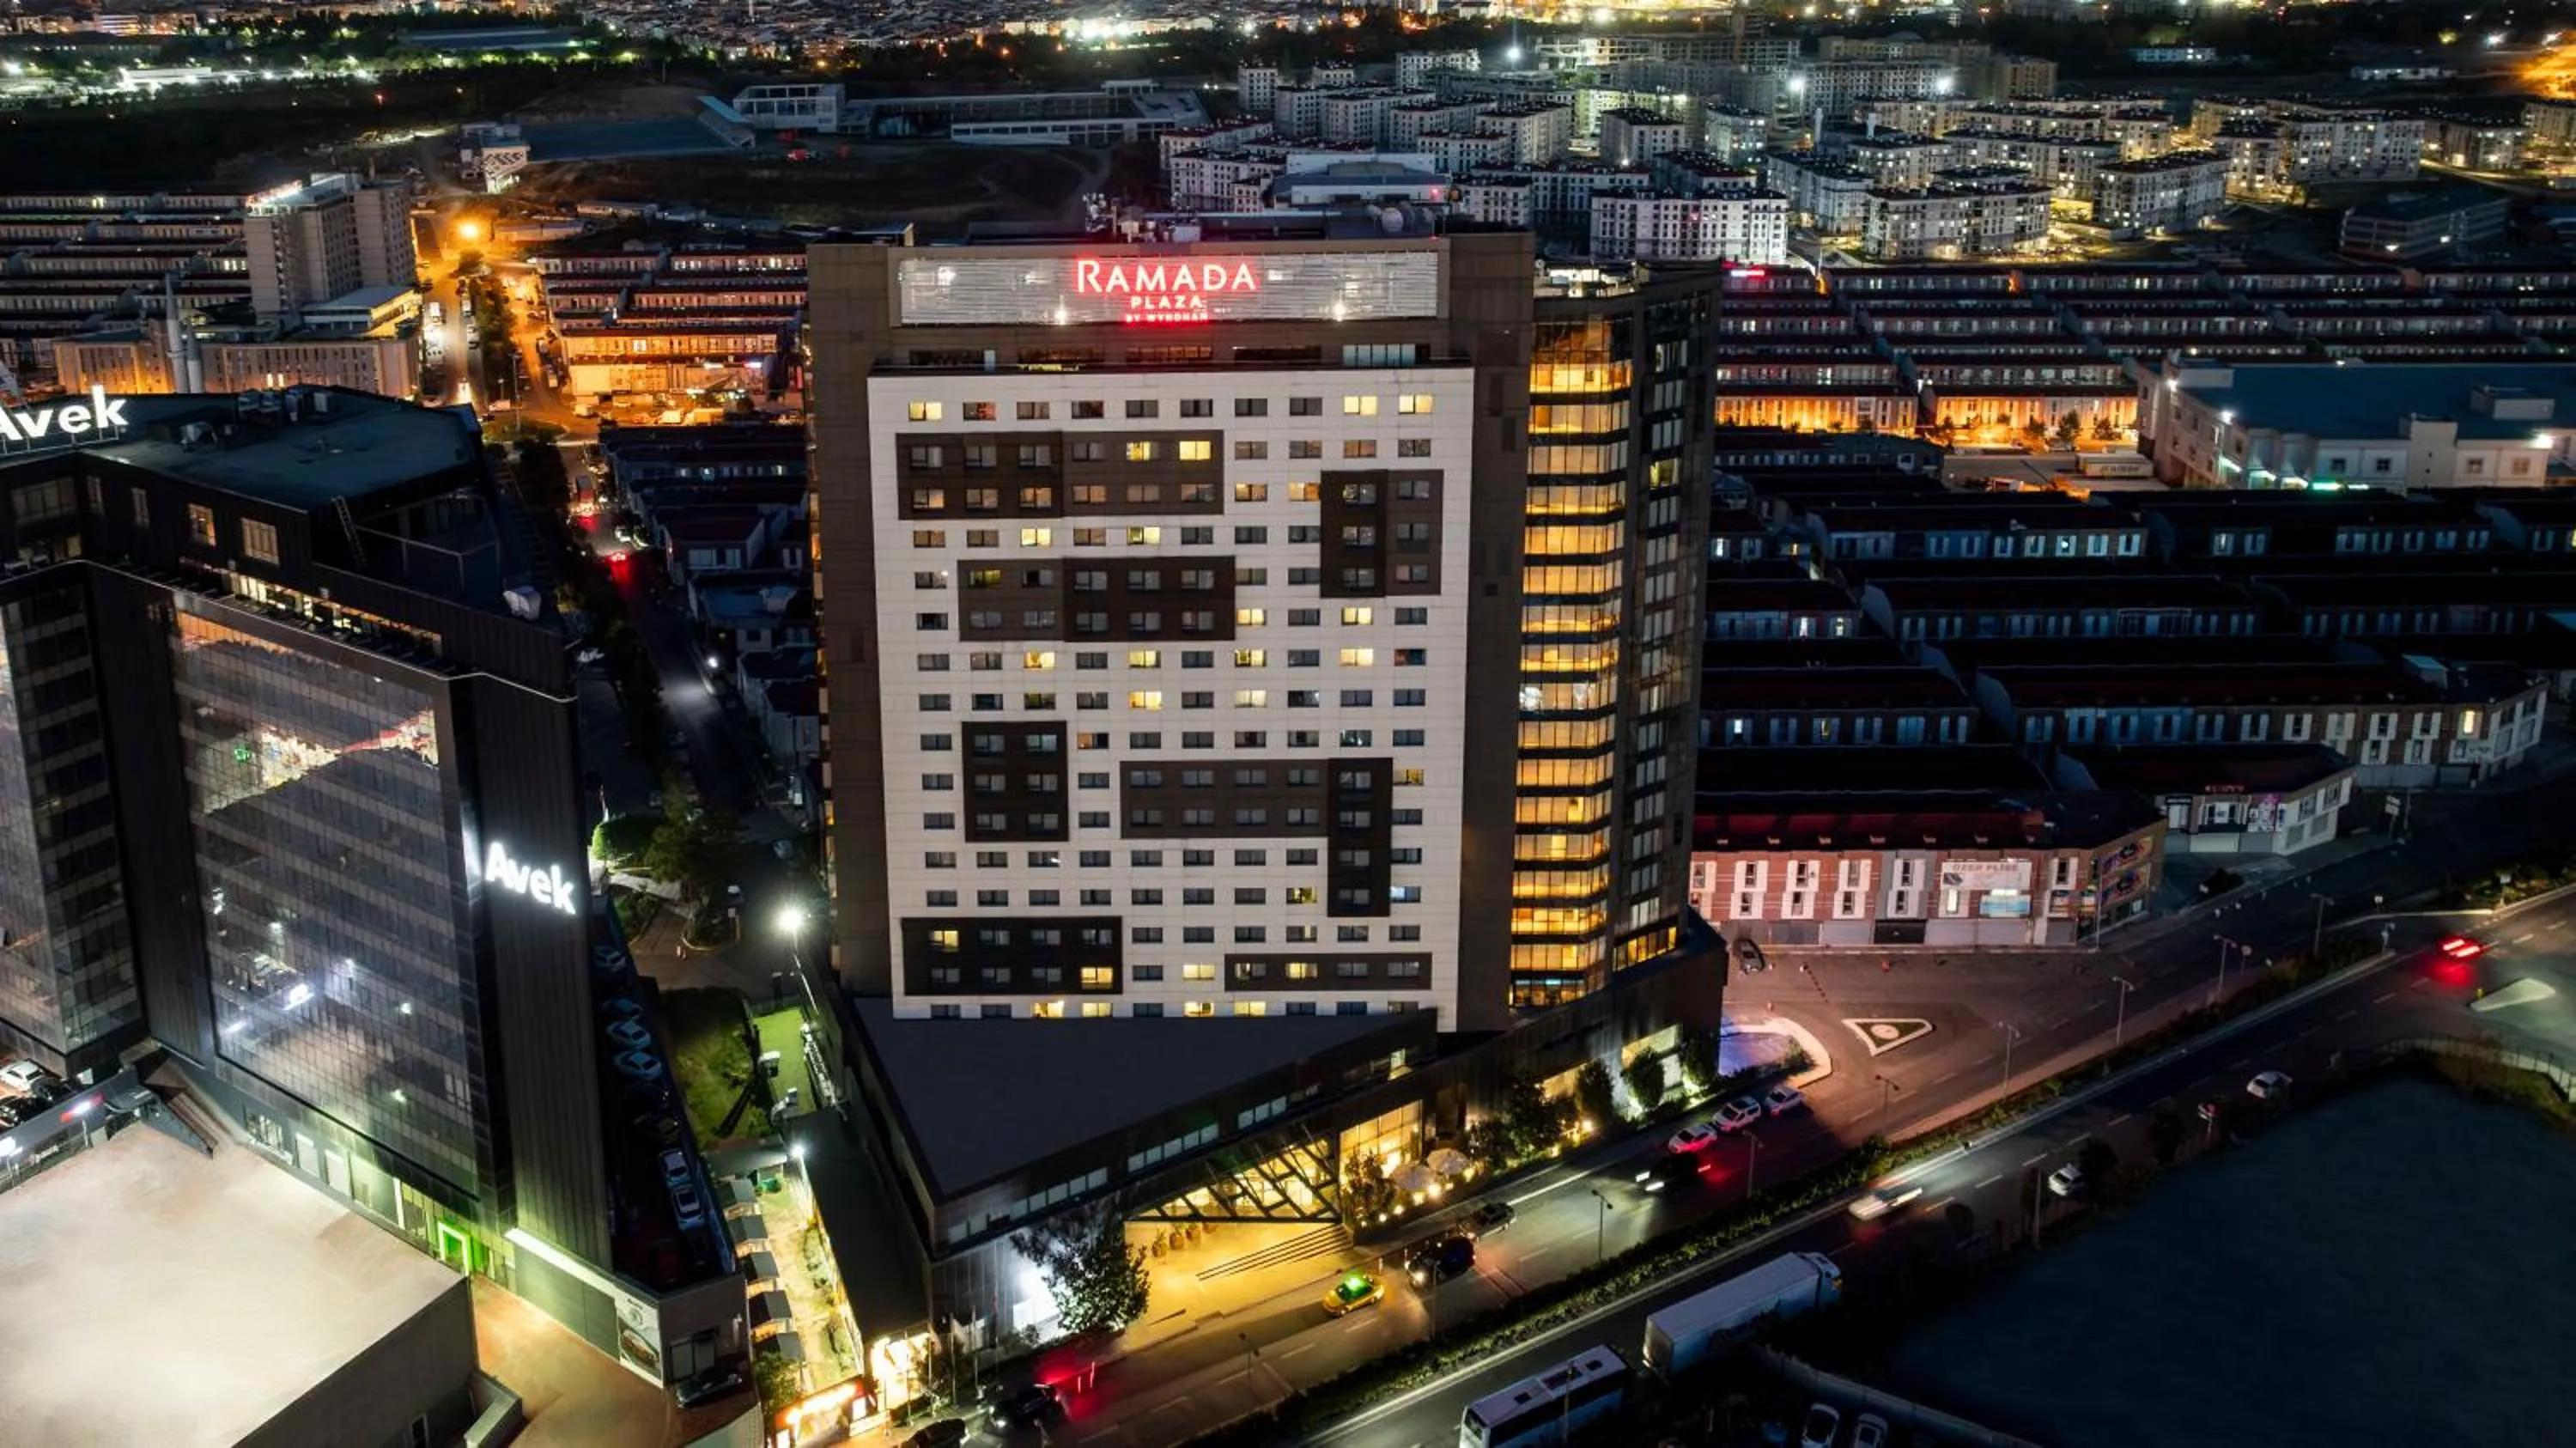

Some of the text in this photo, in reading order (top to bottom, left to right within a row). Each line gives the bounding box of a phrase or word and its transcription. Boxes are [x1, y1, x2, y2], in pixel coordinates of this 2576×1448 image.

[1077, 259, 1256, 293] RAMADA
[1130, 295, 1203, 309] PLAZA
[1126, 313, 1141, 323] BY
[485, 841, 577, 916] Avek
